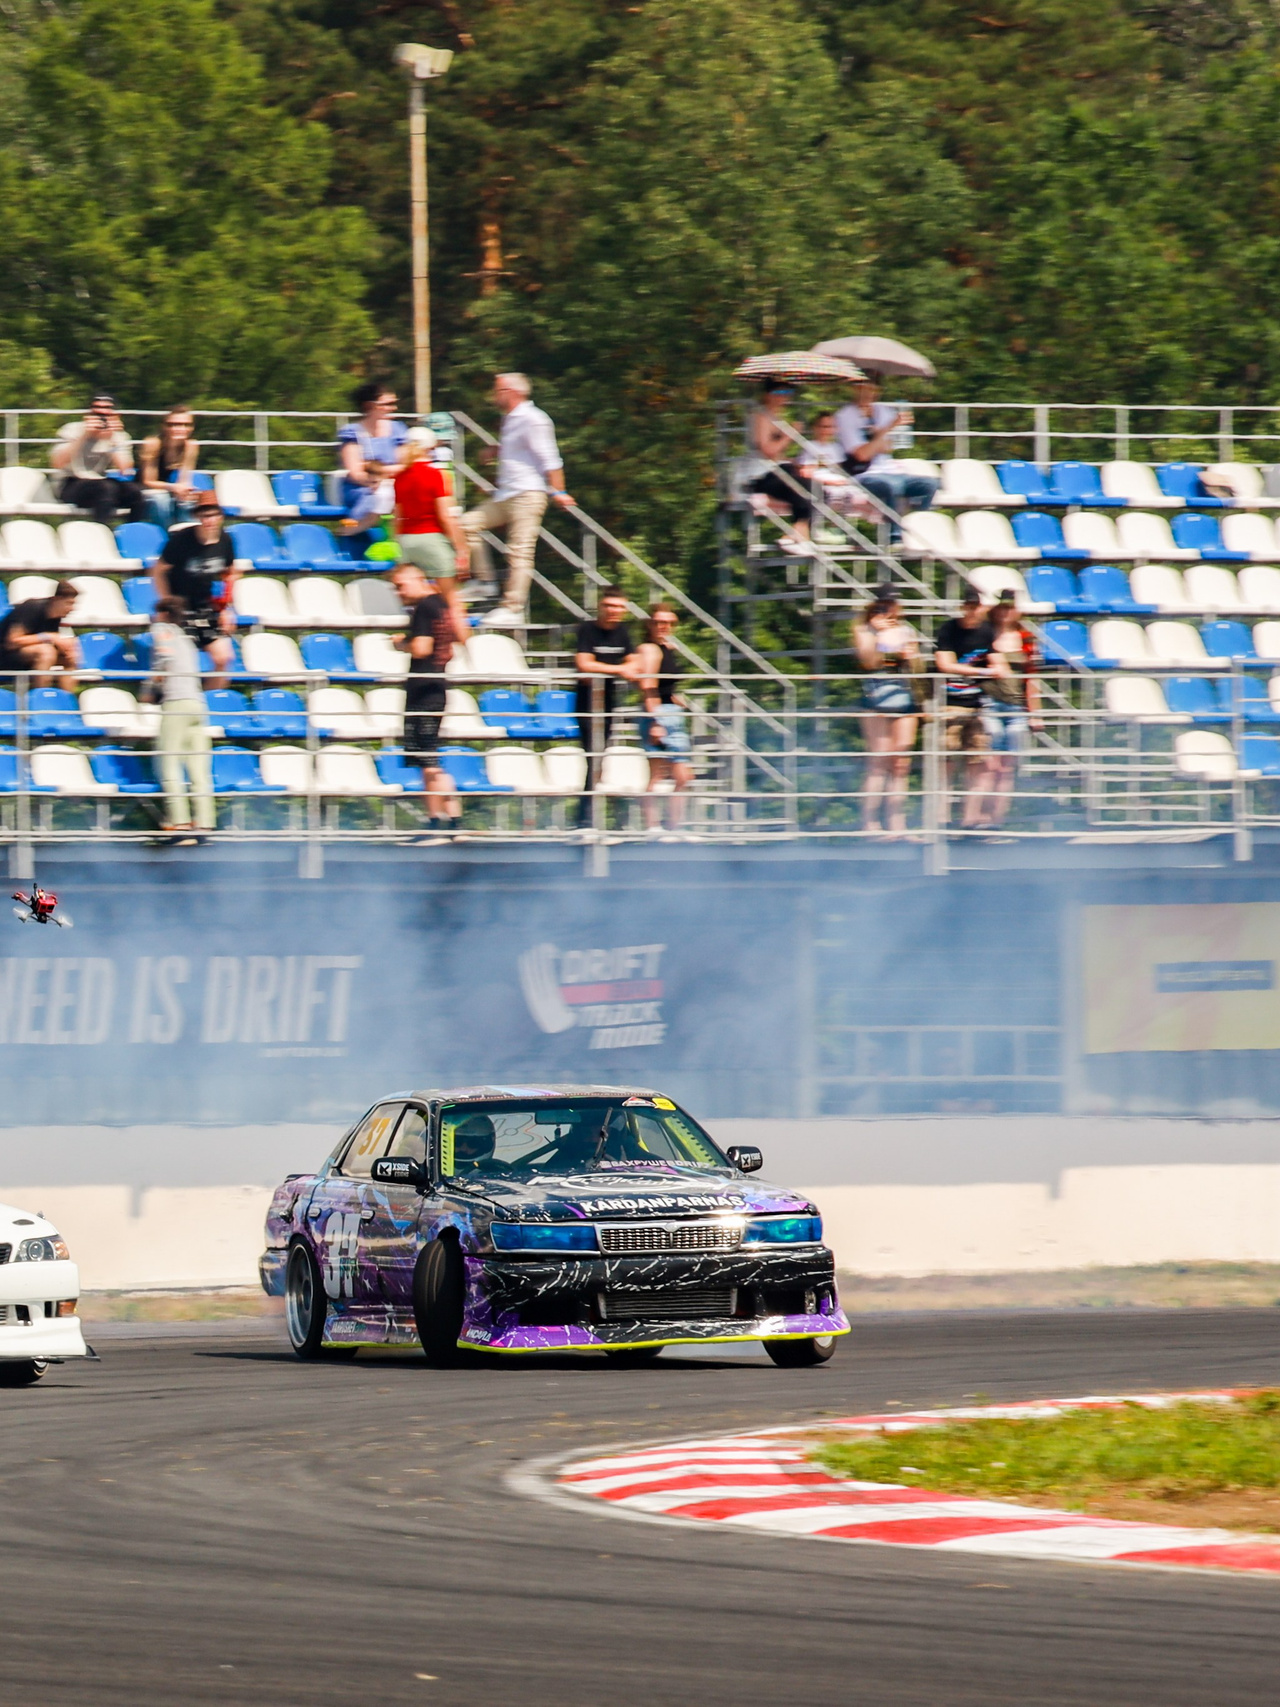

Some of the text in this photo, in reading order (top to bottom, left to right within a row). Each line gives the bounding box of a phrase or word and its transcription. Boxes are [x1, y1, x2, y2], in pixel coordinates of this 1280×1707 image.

[129, 955, 192, 1044] IS
[200, 955, 364, 1044] DRIFT
[581, 1195, 746, 1212] KARDANPARNAS
